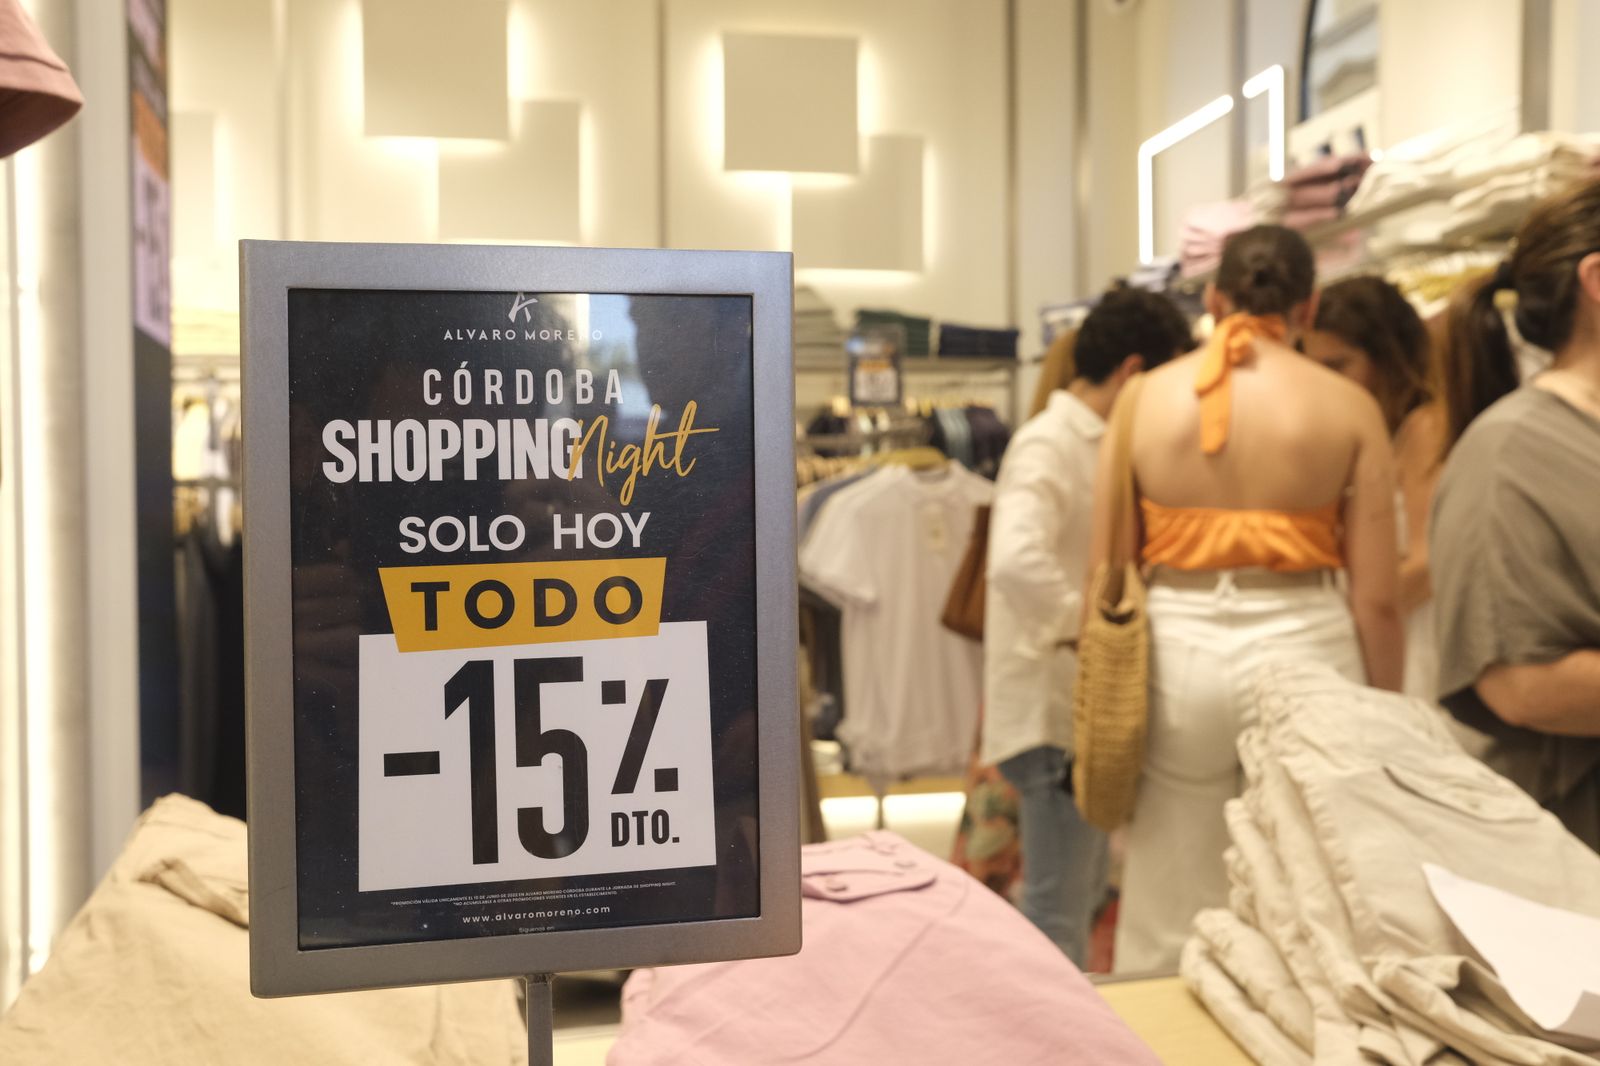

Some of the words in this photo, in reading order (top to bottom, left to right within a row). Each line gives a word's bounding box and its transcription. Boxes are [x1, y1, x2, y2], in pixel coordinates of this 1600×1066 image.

[443, 329, 516, 341] ALVARO
[422, 361, 624, 406] CÓRDOBA
[322, 418, 583, 484] SHOPPING
[566, 400, 720, 506] Night
[399, 514, 526, 554] SOLO
[553, 511, 651, 550] HOY
[410, 575, 643, 632] TODO
[383, 656, 679, 866] -15%
[611, 808, 680, 848] DTO.
[462, 906, 611, 923] www.alvaromoreno.com
